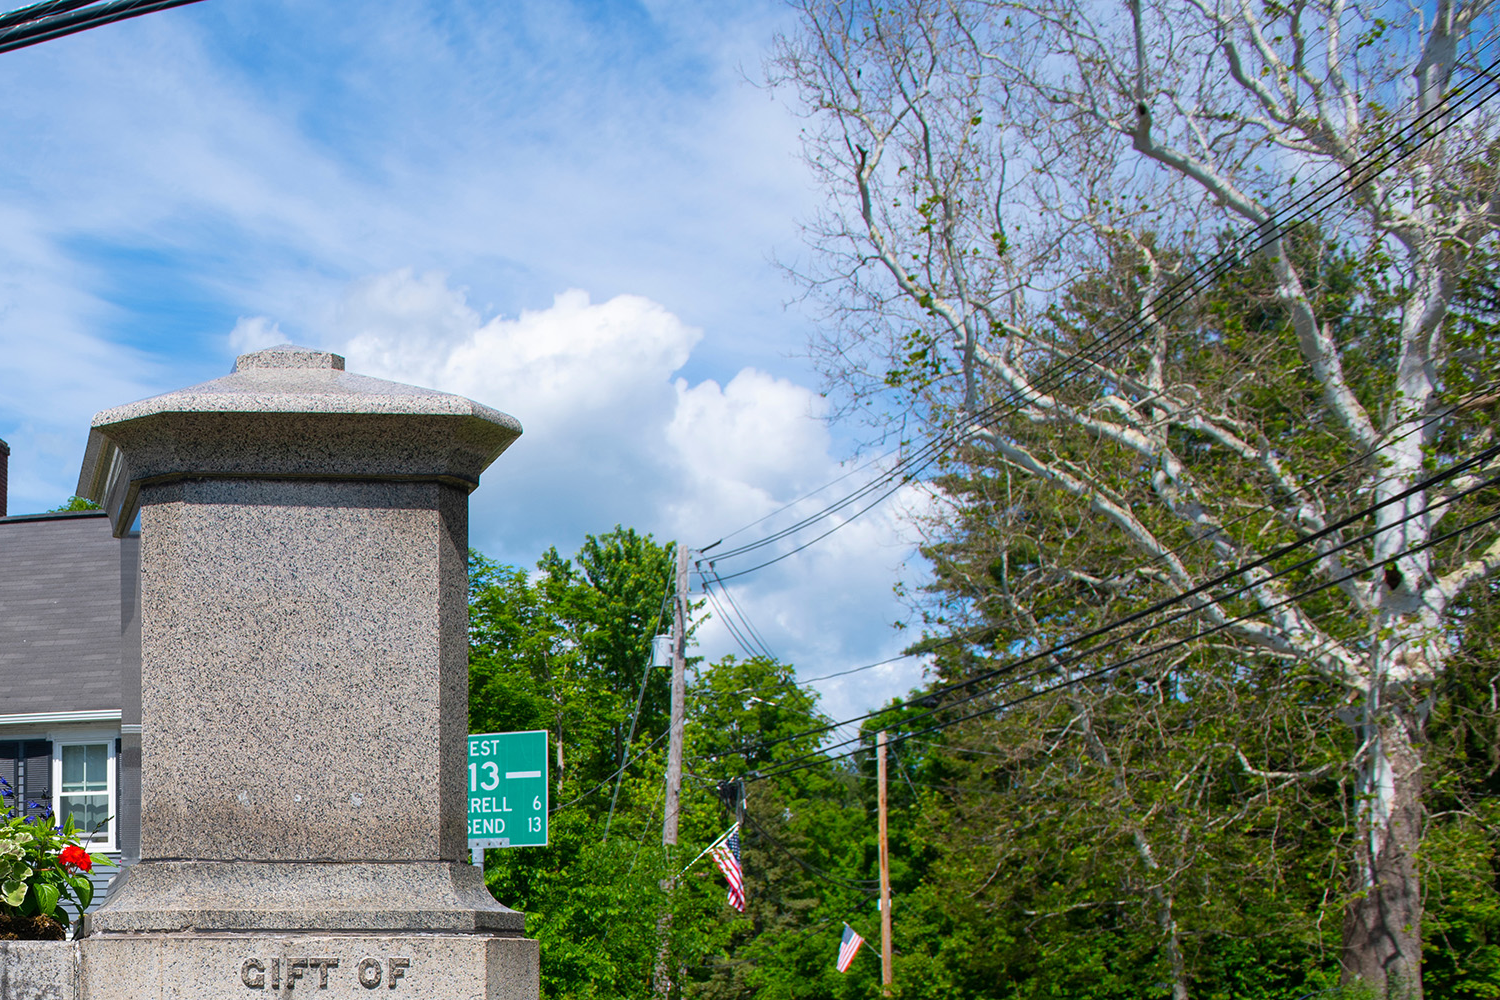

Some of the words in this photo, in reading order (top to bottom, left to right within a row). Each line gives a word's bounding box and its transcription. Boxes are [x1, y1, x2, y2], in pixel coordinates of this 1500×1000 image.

[468, 740, 500, 756] EST
[468, 761, 500, 791] 13
[468, 797, 512, 813] RELL
[532, 795, 542, 811] 6
[527, 816, 541, 832] 13
[240, 956, 339, 989] GIFT
[357, 956, 410, 989] OF
